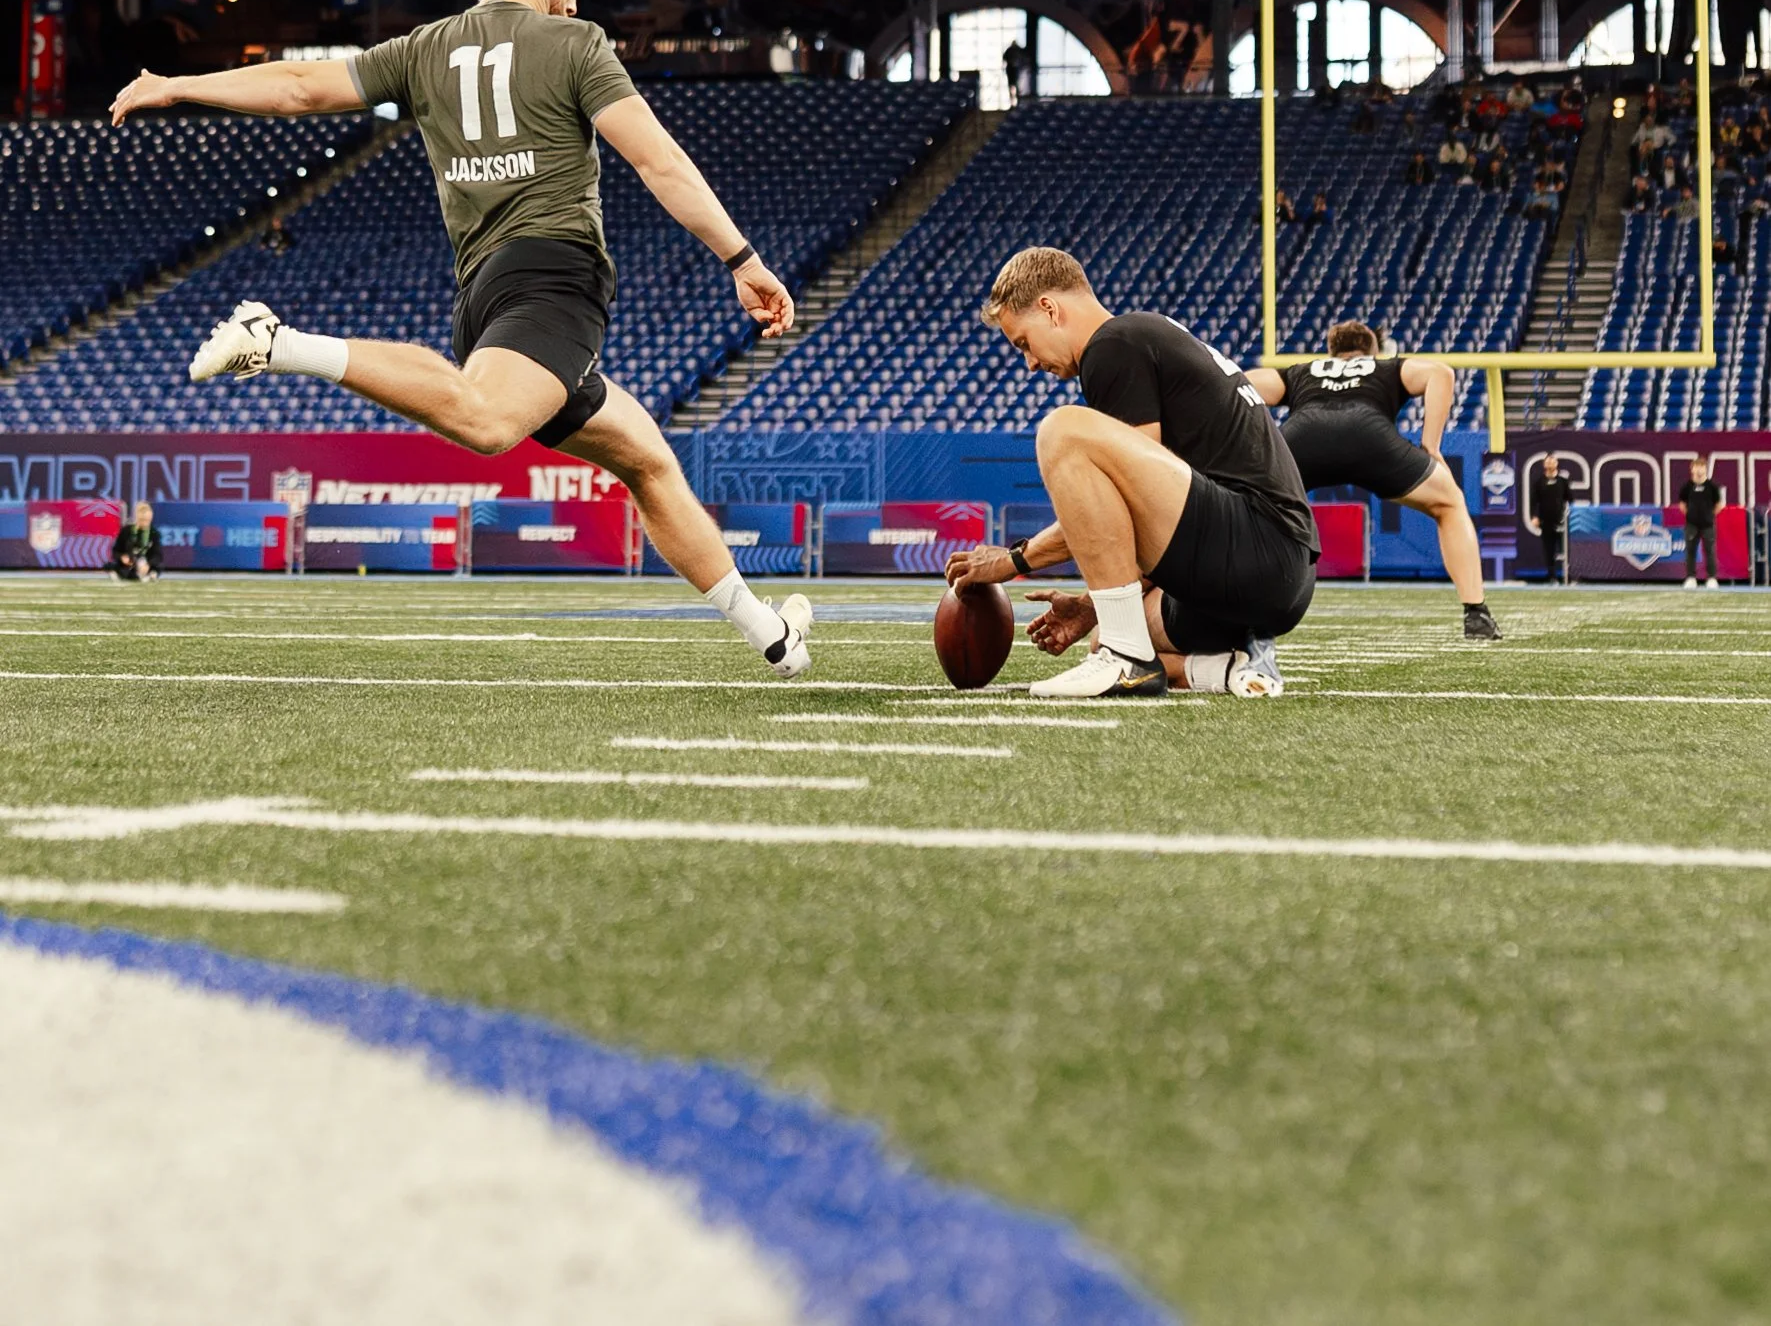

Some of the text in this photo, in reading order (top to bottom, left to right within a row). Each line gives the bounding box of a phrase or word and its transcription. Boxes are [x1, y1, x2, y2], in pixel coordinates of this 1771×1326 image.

[449, 41, 517, 141] 11
[444, 150, 536, 182] JACKSON
[314, 479, 503, 506] NETWORK
[159, 526, 199, 547] EXT
[518, 526, 577, 541] RESPECT
[868, 529, 938, 545] INTEGRITY
